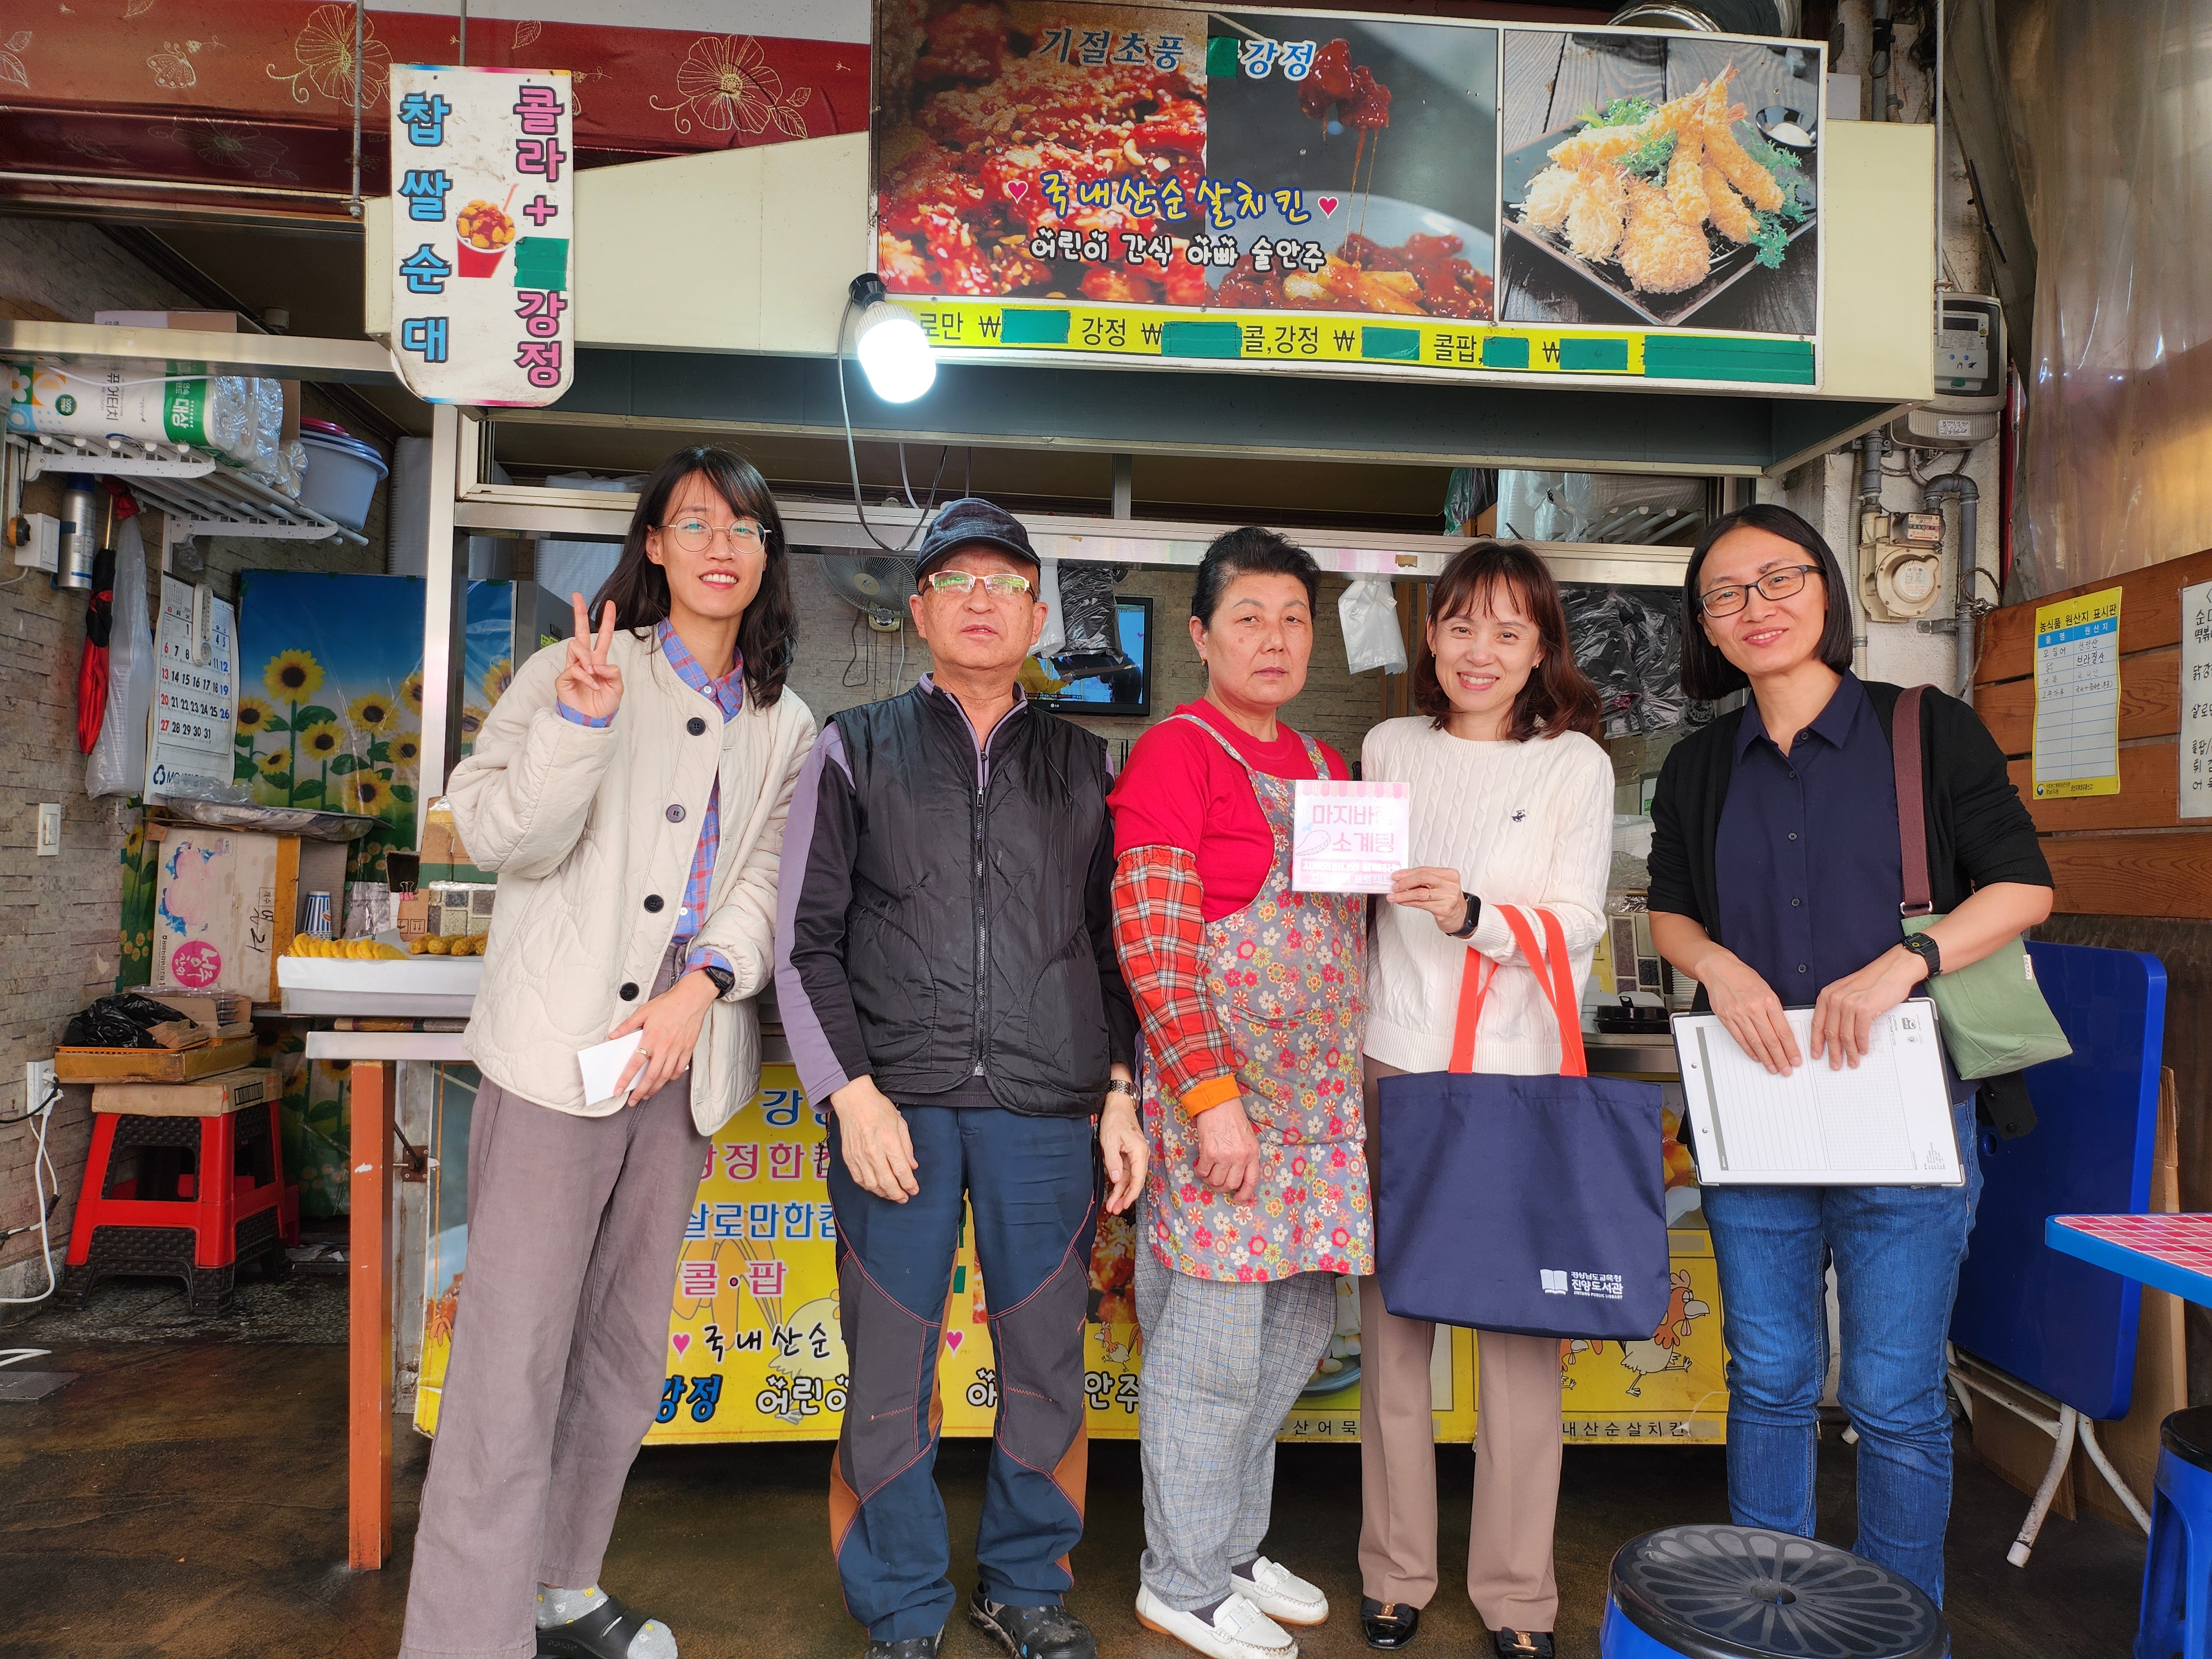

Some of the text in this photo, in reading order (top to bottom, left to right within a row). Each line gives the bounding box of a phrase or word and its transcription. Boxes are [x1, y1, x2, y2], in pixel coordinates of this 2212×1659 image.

[1040, 27, 1316, 81] 기절초풍 강정
[1030, 226, 1326, 272] 어린이 간식 아빠 술안주
[1082, 318, 1126, 346] 강정
[172, 398, 190, 429] 대상
[2040, 603, 2116, 633] 농식품 원산지 표시판
[216, 634, 219, 645] 4
[223, 637, 226, 648] 5
[165, 642, 168, 654] 6
[175, 645, 179, 656] 7
[186, 649, 189, 660] 8
[221, 661, 228, 672] 12
[2043, 647, 2065, 658] 오징어
[2077, 651, 2104, 666] 브라질산
[162, 668, 228, 695] 13 14 15 16 17 18 19
[2193, 662, 2212, 681] 닭강
[161, 693, 229, 719] 20 21 22 23 24 25 26
[161, 719, 211, 739] 27 28 29 30 31
[263, 891, 271, 904] 개수
[1571, 1271, 1621, 1282] 경상남도교육청
[1571, 1279, 1623, 1295] 진양도서관
[1280, 1420, 1357, 1435] 산어묵
